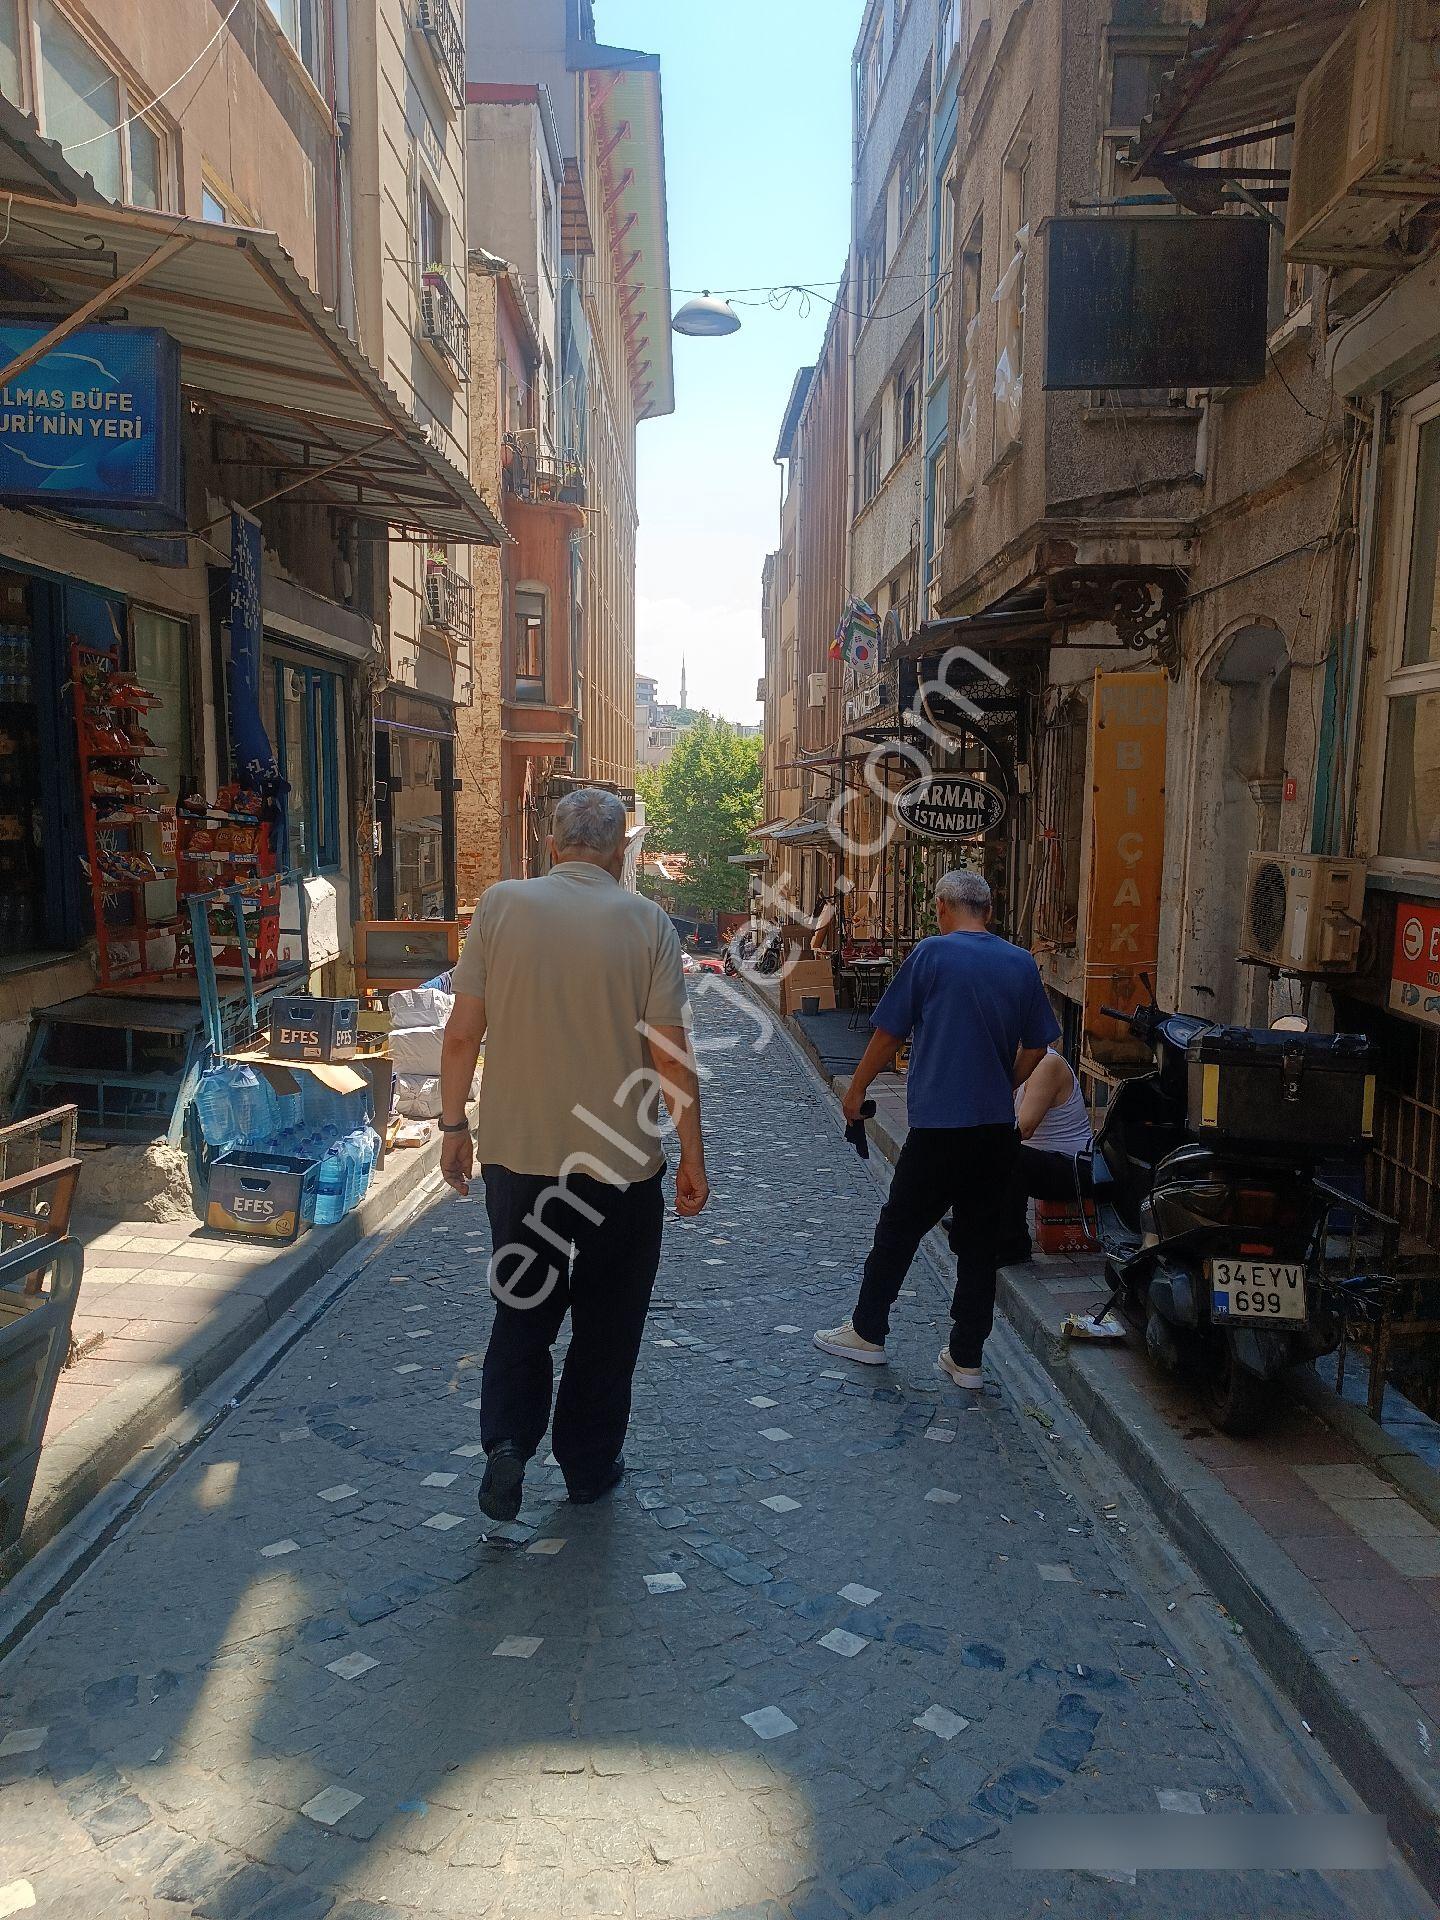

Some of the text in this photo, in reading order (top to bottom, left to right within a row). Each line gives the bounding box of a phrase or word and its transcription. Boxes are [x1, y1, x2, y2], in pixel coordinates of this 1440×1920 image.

[0, 387, 133, 412] LMAS BÜFE
[90, 416, 142, 439] YERİ
[918, 784, 986, 810] ARMAR
[914, 805, 985, 831] İSTANBUL
[280, 1028, 320, 1045] EFES
[336, 1029, 353, 1047] EFES
[233, 1196, 274, 1215] EFES
[1217, 1305, 1228, 1313] TR
[1235, 1290, 1281, 1314] 699
